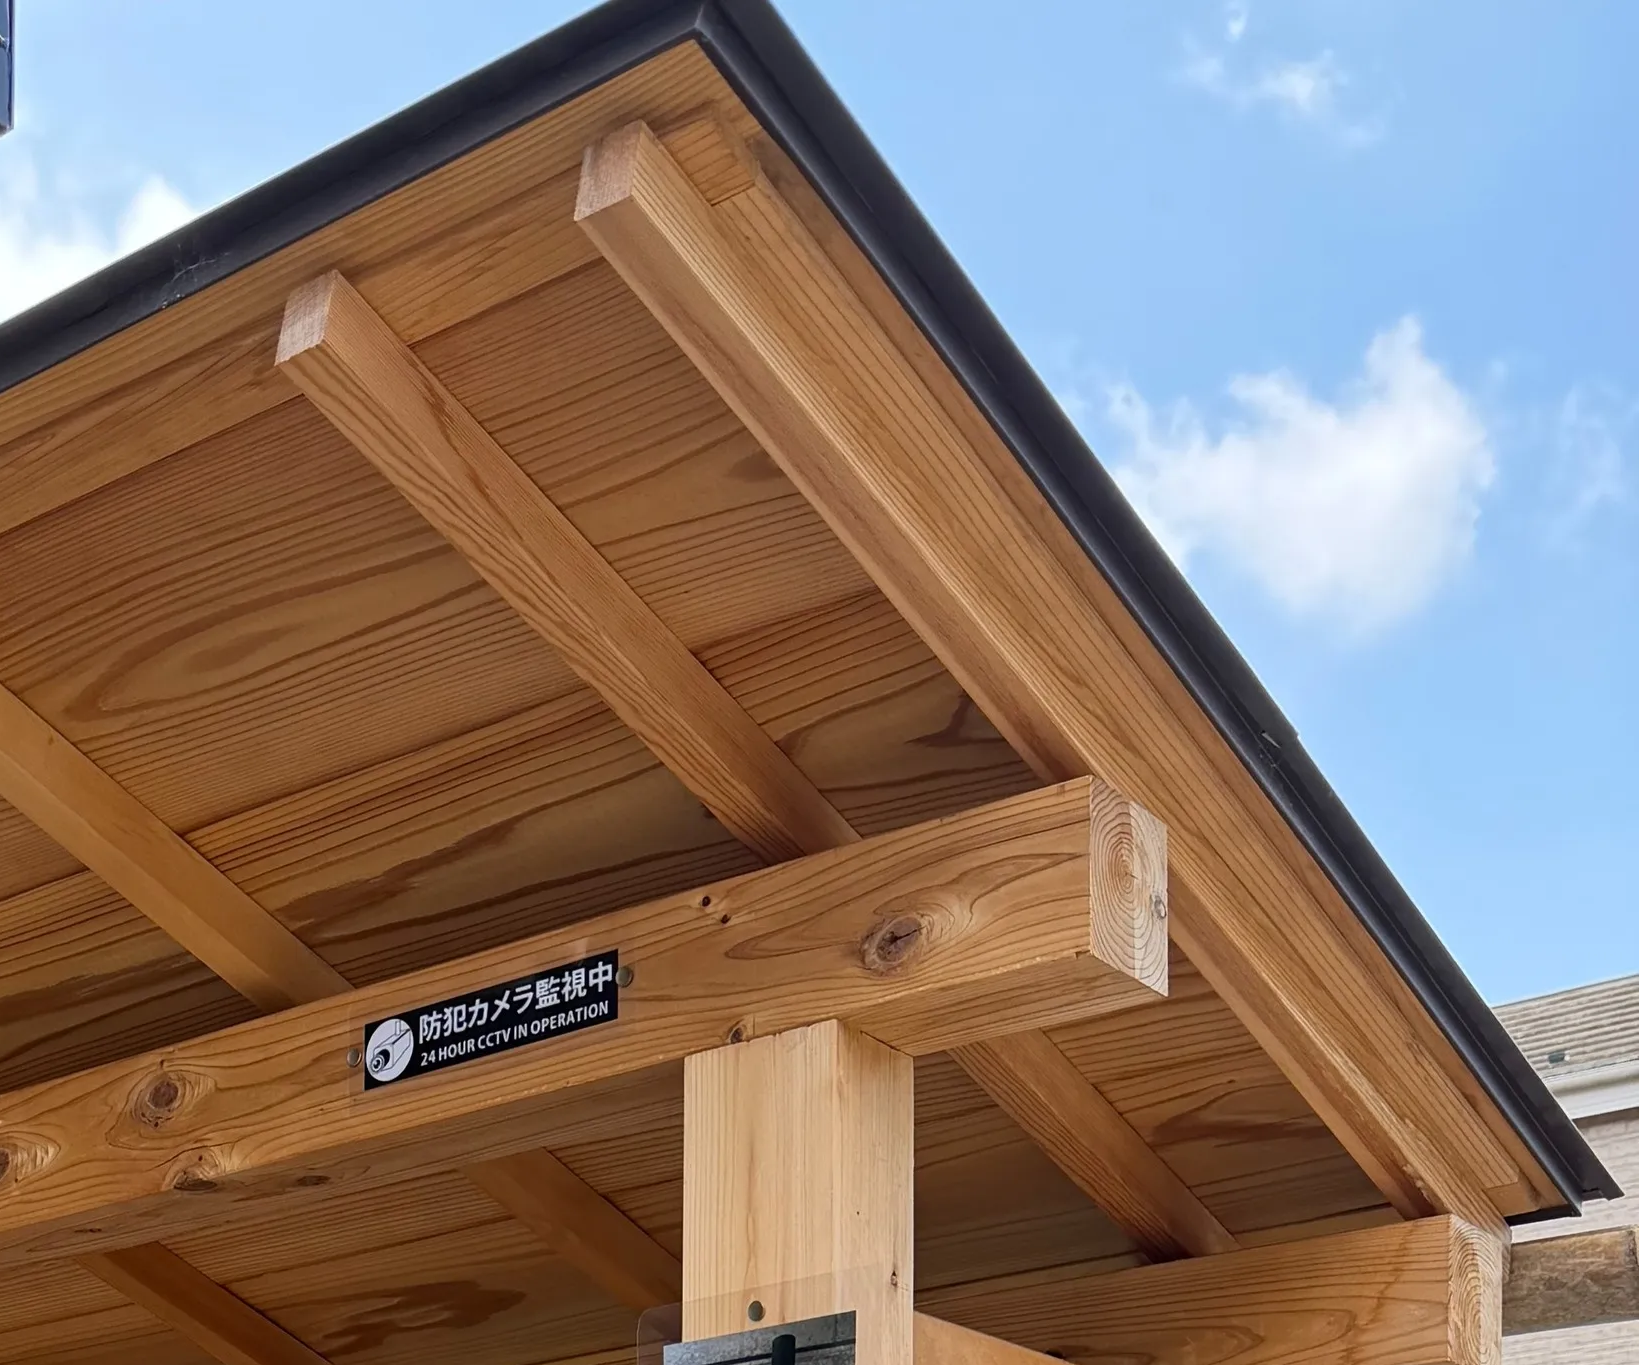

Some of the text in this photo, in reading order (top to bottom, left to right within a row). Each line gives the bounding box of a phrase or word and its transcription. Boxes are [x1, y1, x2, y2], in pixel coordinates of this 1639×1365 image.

[418, 961, 613, 1045] 防犯カメラ監視中
[421, 1000, 609, 1067] 24 HOUR CCTV IN OPERATION
